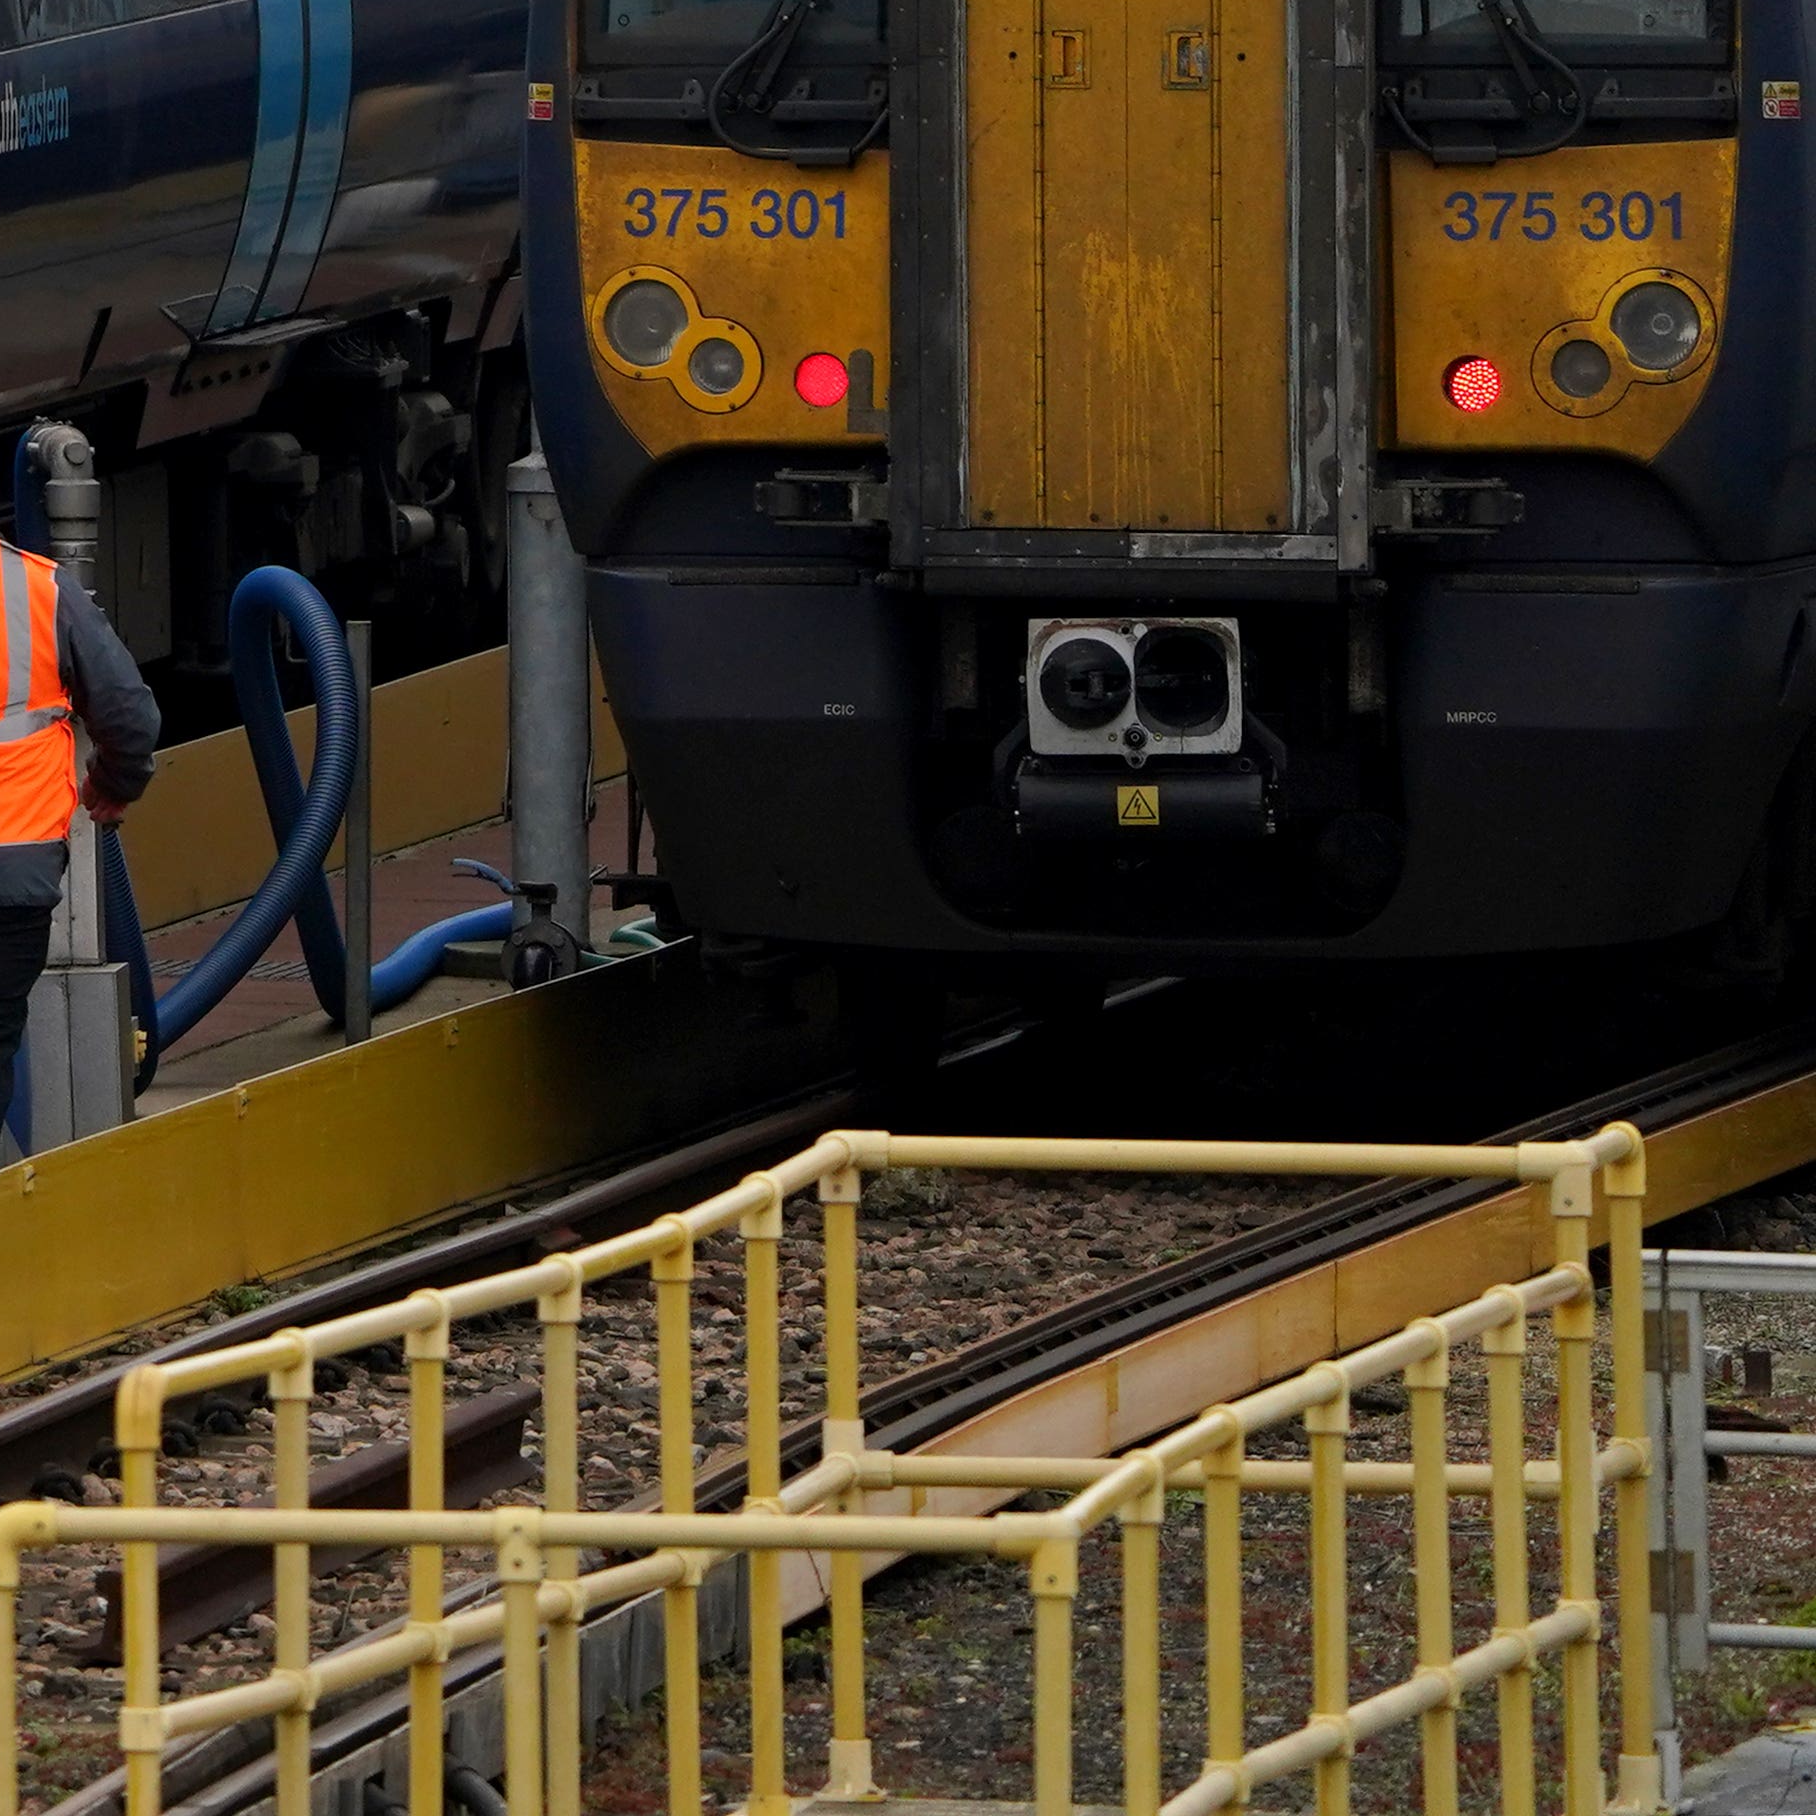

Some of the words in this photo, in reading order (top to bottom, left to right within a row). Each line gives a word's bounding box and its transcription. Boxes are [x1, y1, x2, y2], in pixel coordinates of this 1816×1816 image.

[624, 188, 727, 239] 375
[751, 187, 847, 239] 301
[1442, 191, 1556, 241] 375
[1580, 189, 1683, 240] 301
[824, 703, 855, 716] ECIC
[1446, 711, 1497, 724] MRPCC
